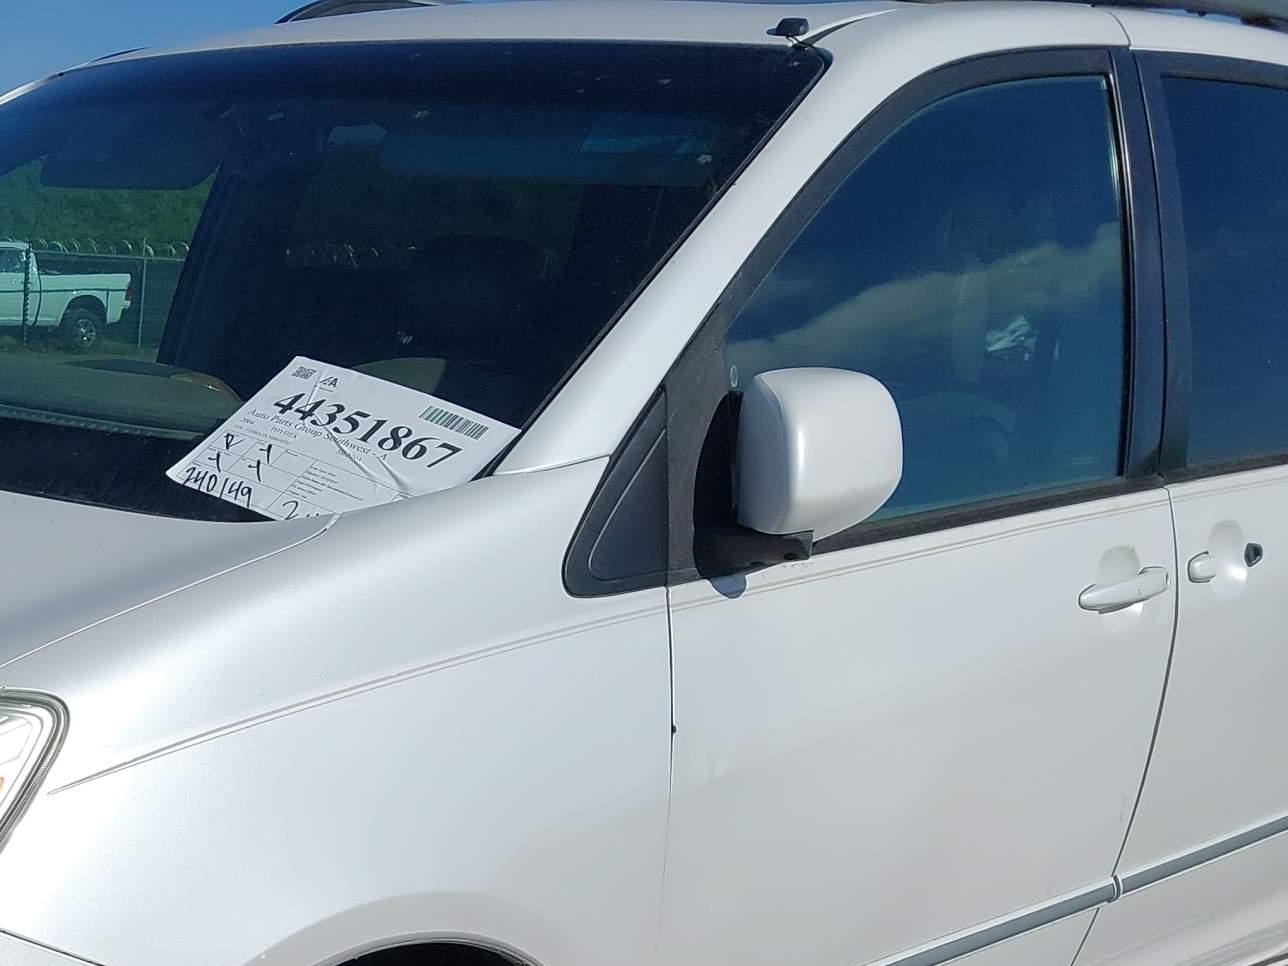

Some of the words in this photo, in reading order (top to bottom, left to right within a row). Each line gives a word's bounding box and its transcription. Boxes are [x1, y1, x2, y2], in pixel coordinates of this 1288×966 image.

[247, 409, 270, 420] Auto
[270, 415, 293, 427] Parts
[294, 422, 323, 438] Group
[323, 432, 372, 455] Southwest
[273, 393, 463, 468] 44351867
